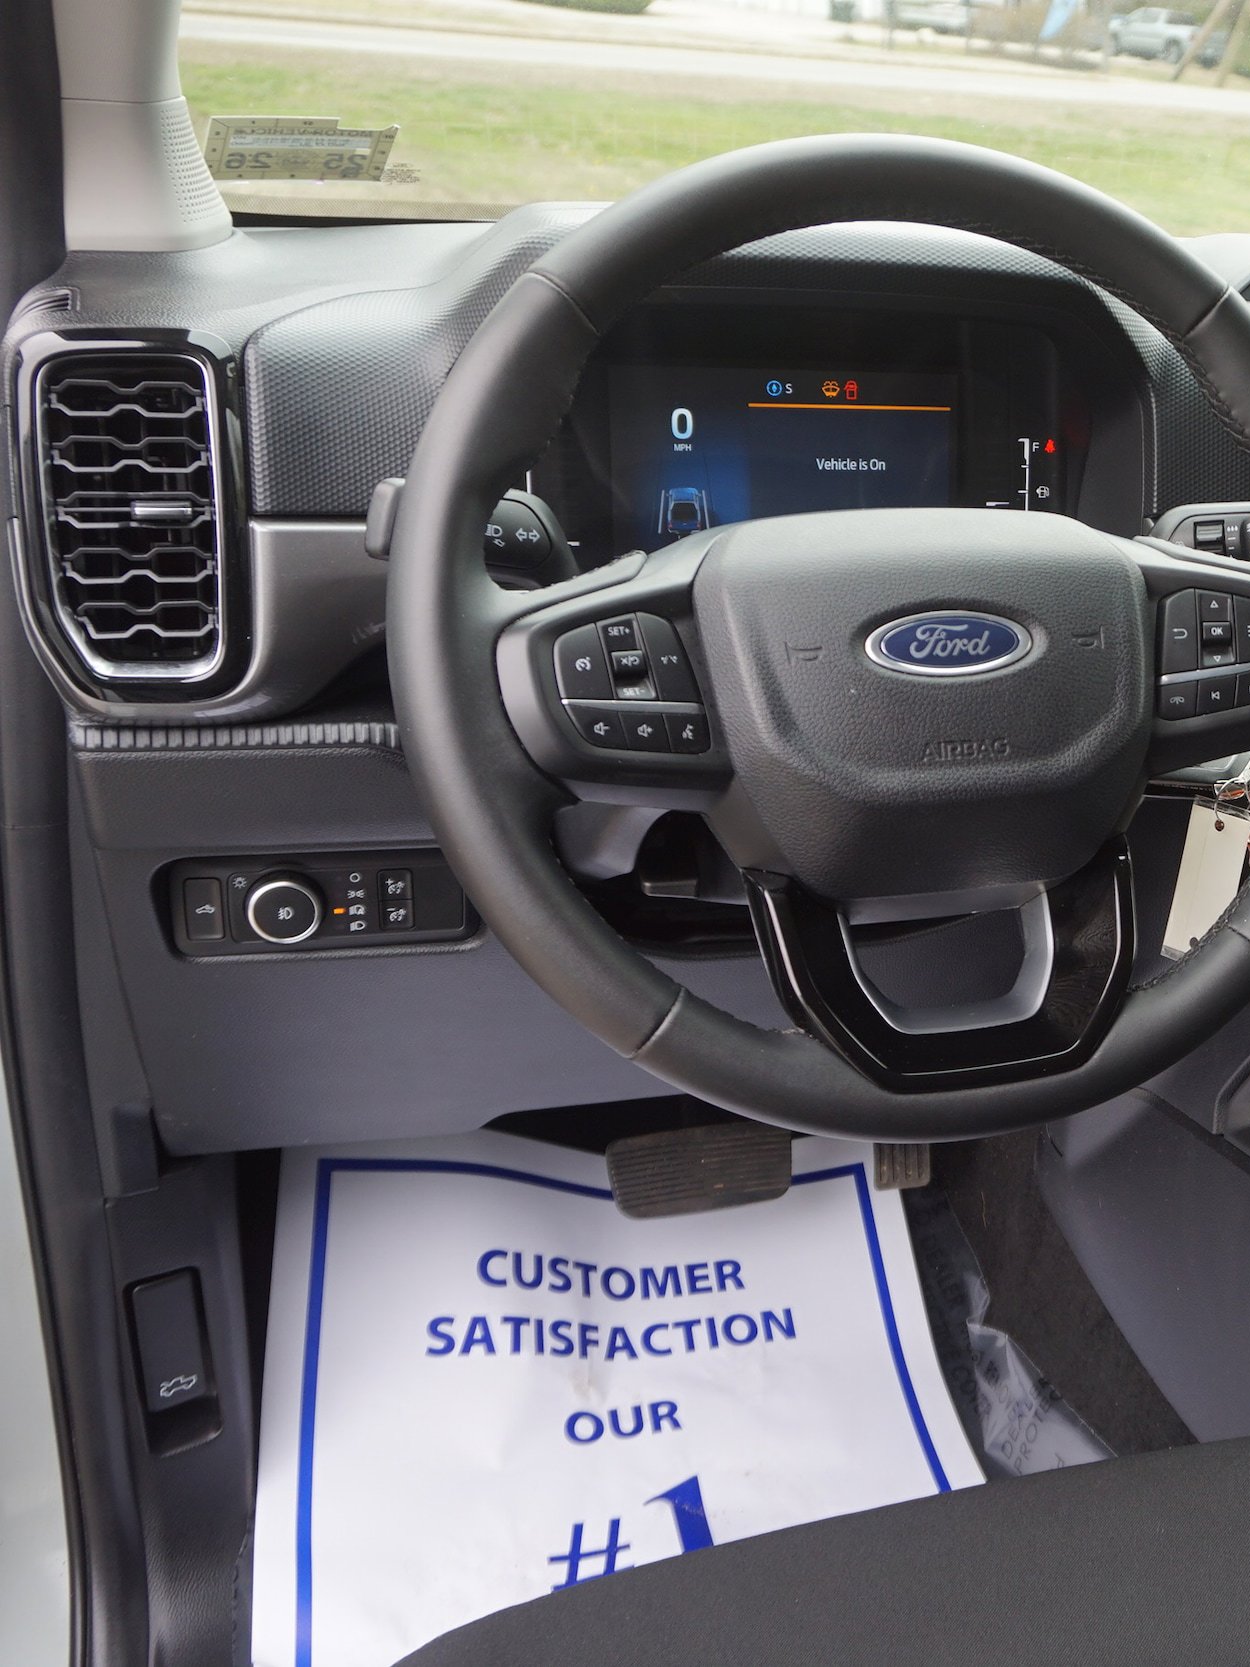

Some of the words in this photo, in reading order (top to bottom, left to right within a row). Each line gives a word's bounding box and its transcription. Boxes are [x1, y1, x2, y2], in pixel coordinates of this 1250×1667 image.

[785, 383, 793, 394] S
[671, 407, 693, 440] 0
[673, 443, 692, 451] MPH
[1032, 442, 1040, 452] F
[816, 458, 857, 470] Vehicle
[859, 458, 868, 470] is
[870, 458, 886, 470] On
[908, 623, 990, 659] Ford
[1211, 627, 1223, 636] OK
[922, 737, 1010, 762] AIRBAG
[476, 1249, 746, 1301] CUSTOMER
[425, 1307, 797, 1361] SATISFACTION
[564, 1400, 682, 1445] OUR
[548, 1475, 714, 1591] #1
